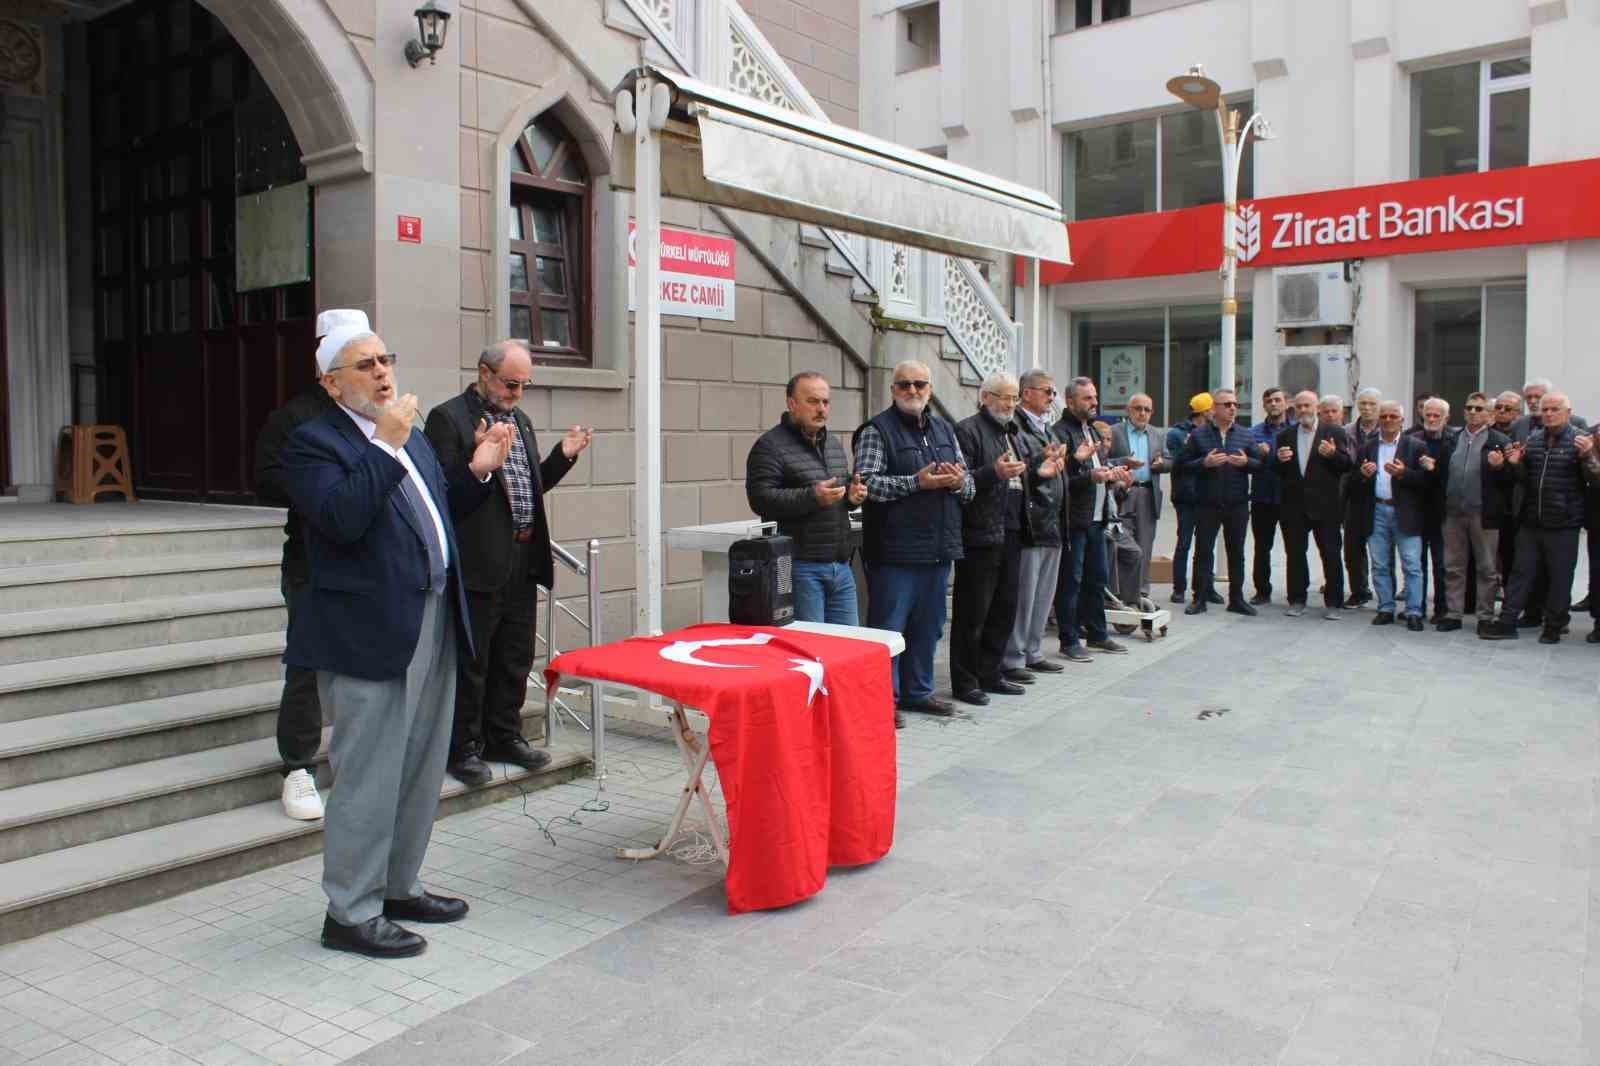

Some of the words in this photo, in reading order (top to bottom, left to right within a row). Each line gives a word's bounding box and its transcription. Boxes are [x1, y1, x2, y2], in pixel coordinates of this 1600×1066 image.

[1272, 208, 1371, 249] Ziraat
[1379, 195, 1525, 239] Bankası
[660, 242, 687, 260] ÜRKELİ
[688, 247, 729, 267] MÜFTÜLÜĞÜ
[660, 281, 687, 302] KEZ
[691, 284, 725, 307] CAMİİ
